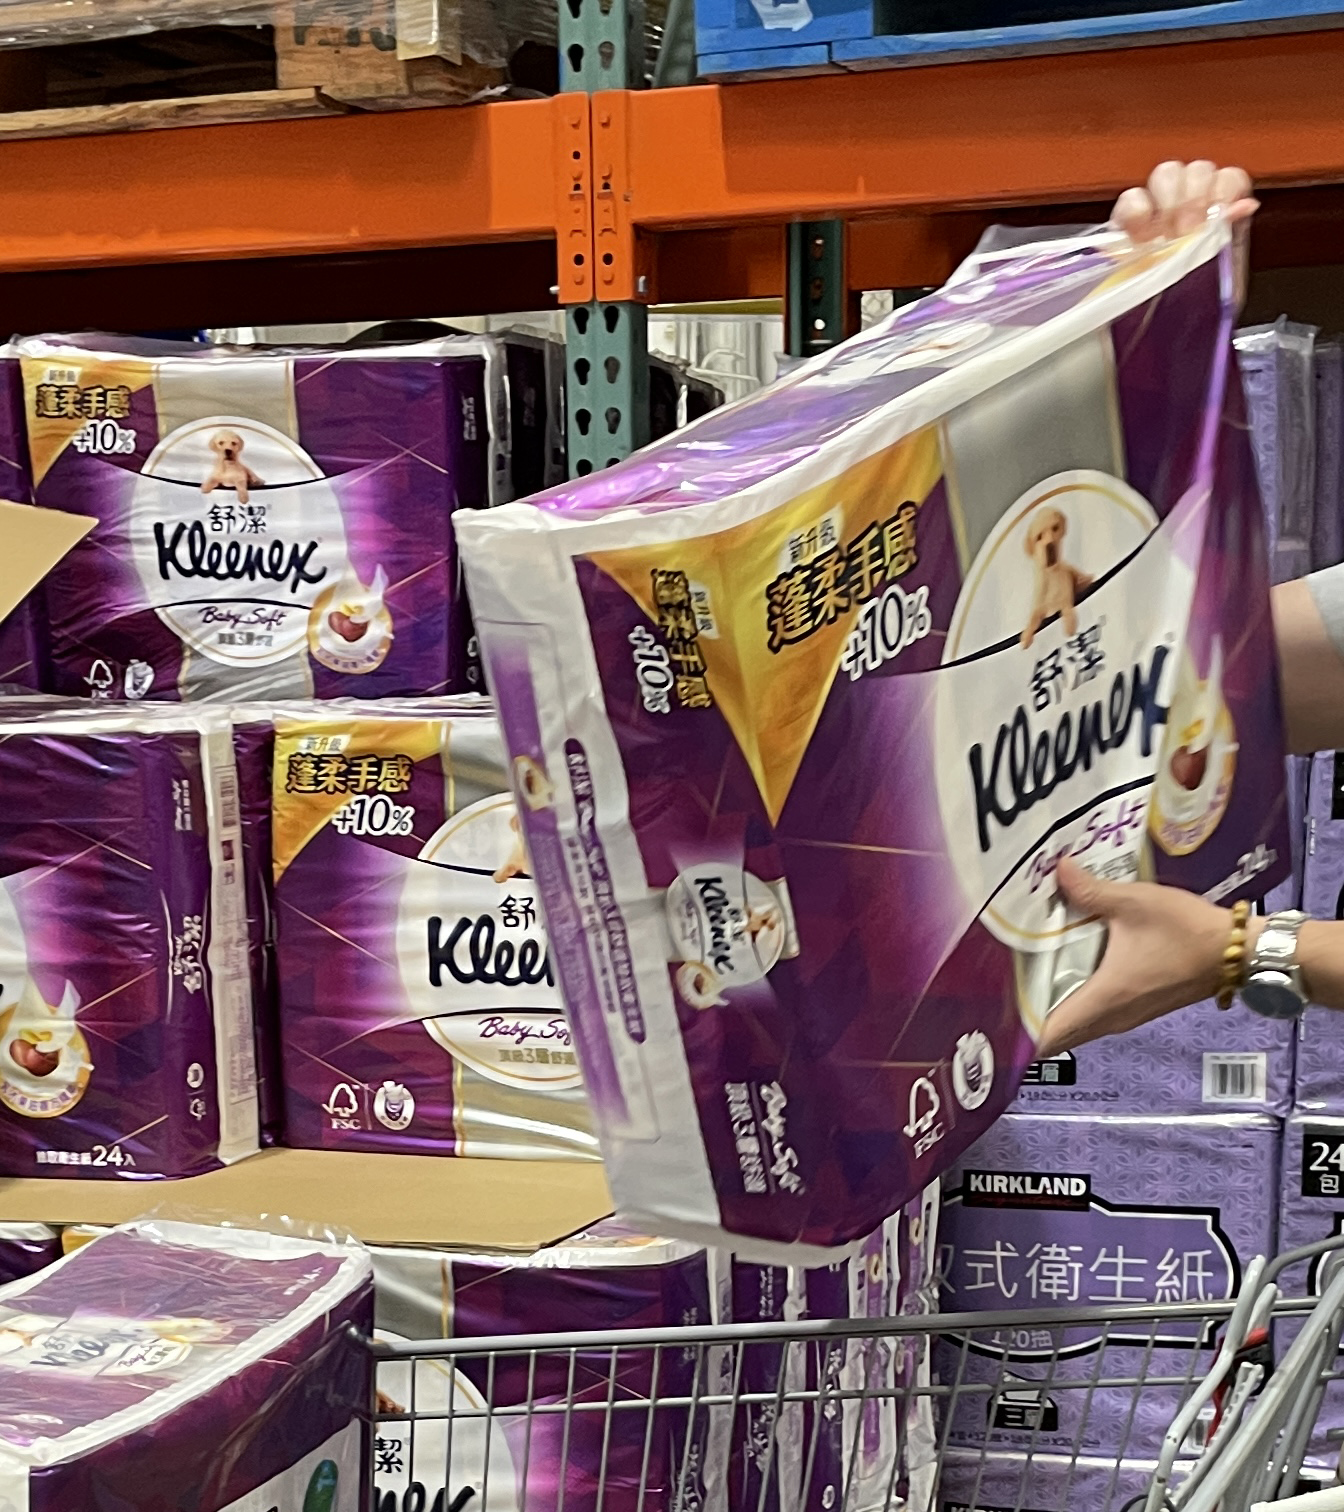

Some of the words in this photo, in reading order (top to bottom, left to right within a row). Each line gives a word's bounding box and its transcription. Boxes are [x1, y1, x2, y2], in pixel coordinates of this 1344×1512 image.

[34, 384, 131, 418] 蓬柔手感
[73, 420, 136, 454] +10%
[208, 504, 267, 534] 舒潔
[153, 520, 327, 593] Kleenex
[285, 754, 414, 795] 蓬柔手感
[333, 795, 414, 837] +10%
[498, 894, 536, 931] 舒
[426, 914, 556, 987] Klee
[478, 1017, 536, 1045] Baby
[331, 1118, 362, 1131] FSC
[969, 1174, 1086, 1197] KIRKLAND
[1319, 1174, 1339, 1195] 包
[940, 1240, 1214, 1304] 式衛生紙
